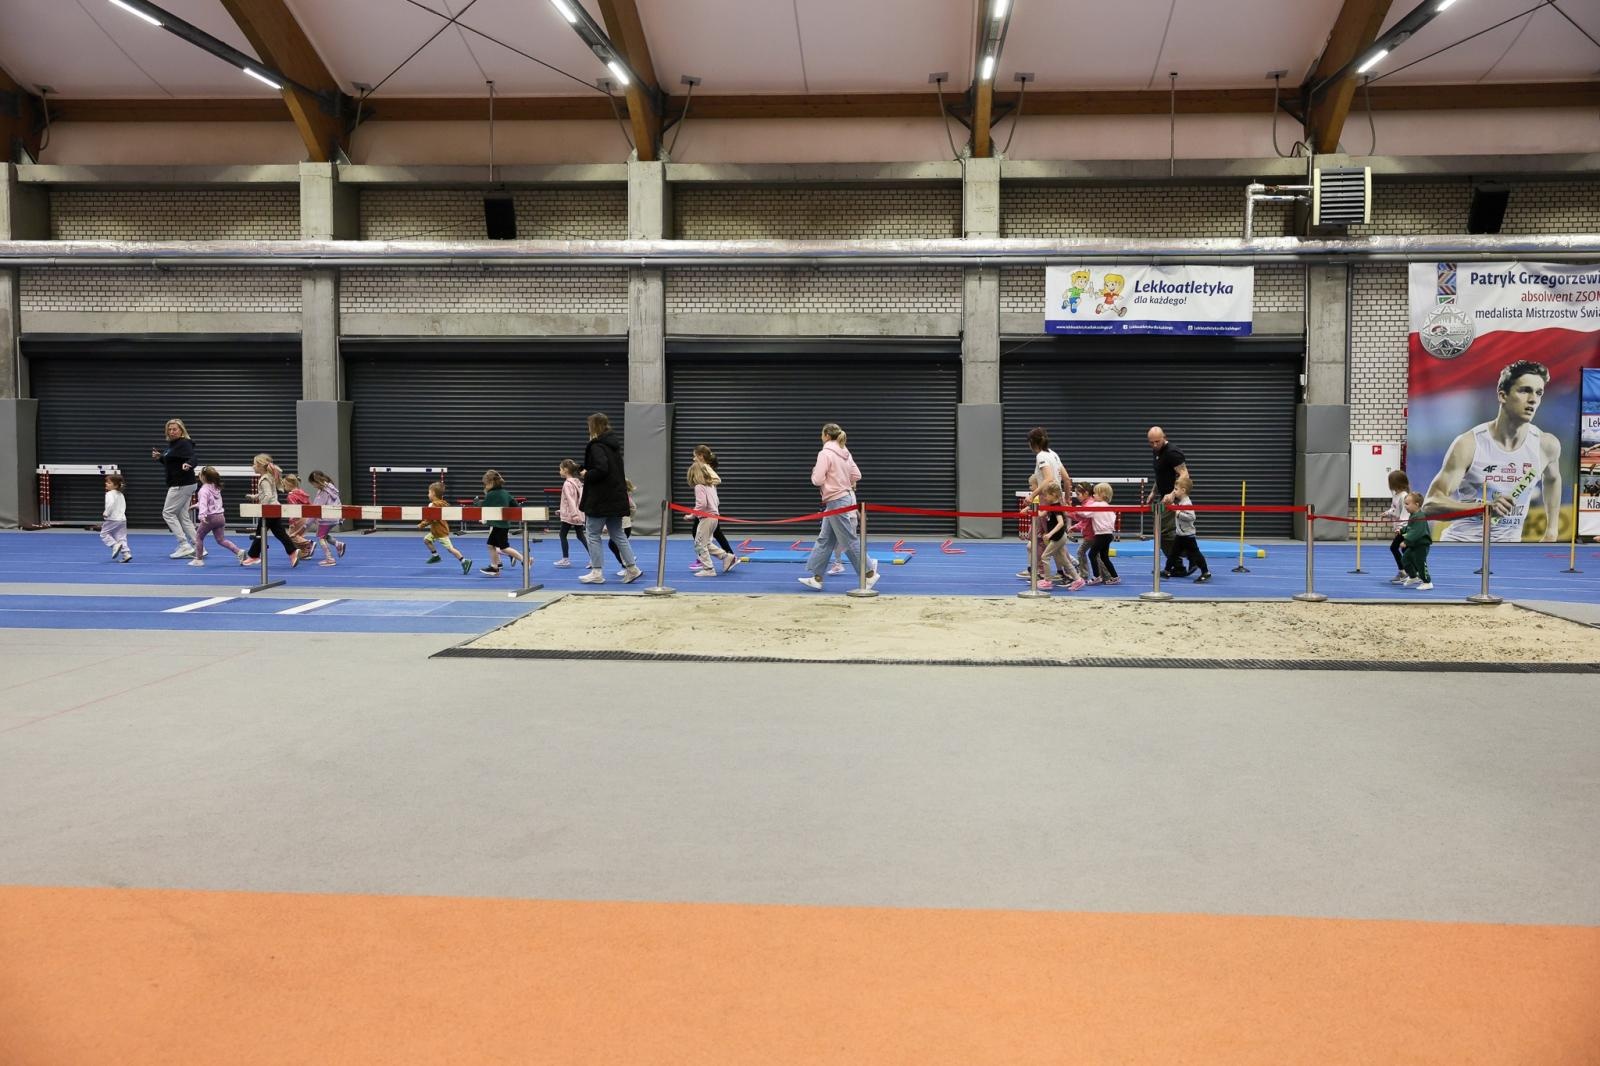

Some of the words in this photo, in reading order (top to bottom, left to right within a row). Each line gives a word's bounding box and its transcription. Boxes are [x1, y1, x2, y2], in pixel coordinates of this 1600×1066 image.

[1470, 271, 1516, 287] Patryk
[1134, 280, 1234, 296] Lekkoatletyka
[1134, 296, 1147, 304] dla
[1149, 296, 1187, 306] każdego!
[1521, 290, 1573, 302] absolwent
[1475, 308, 1523, 318] medalista
[1525, 307, 1578, 318] Mistrzostw
[1483, 465, 1498, 473] 4F
[1485, 475, 1523, 483] POLSK
